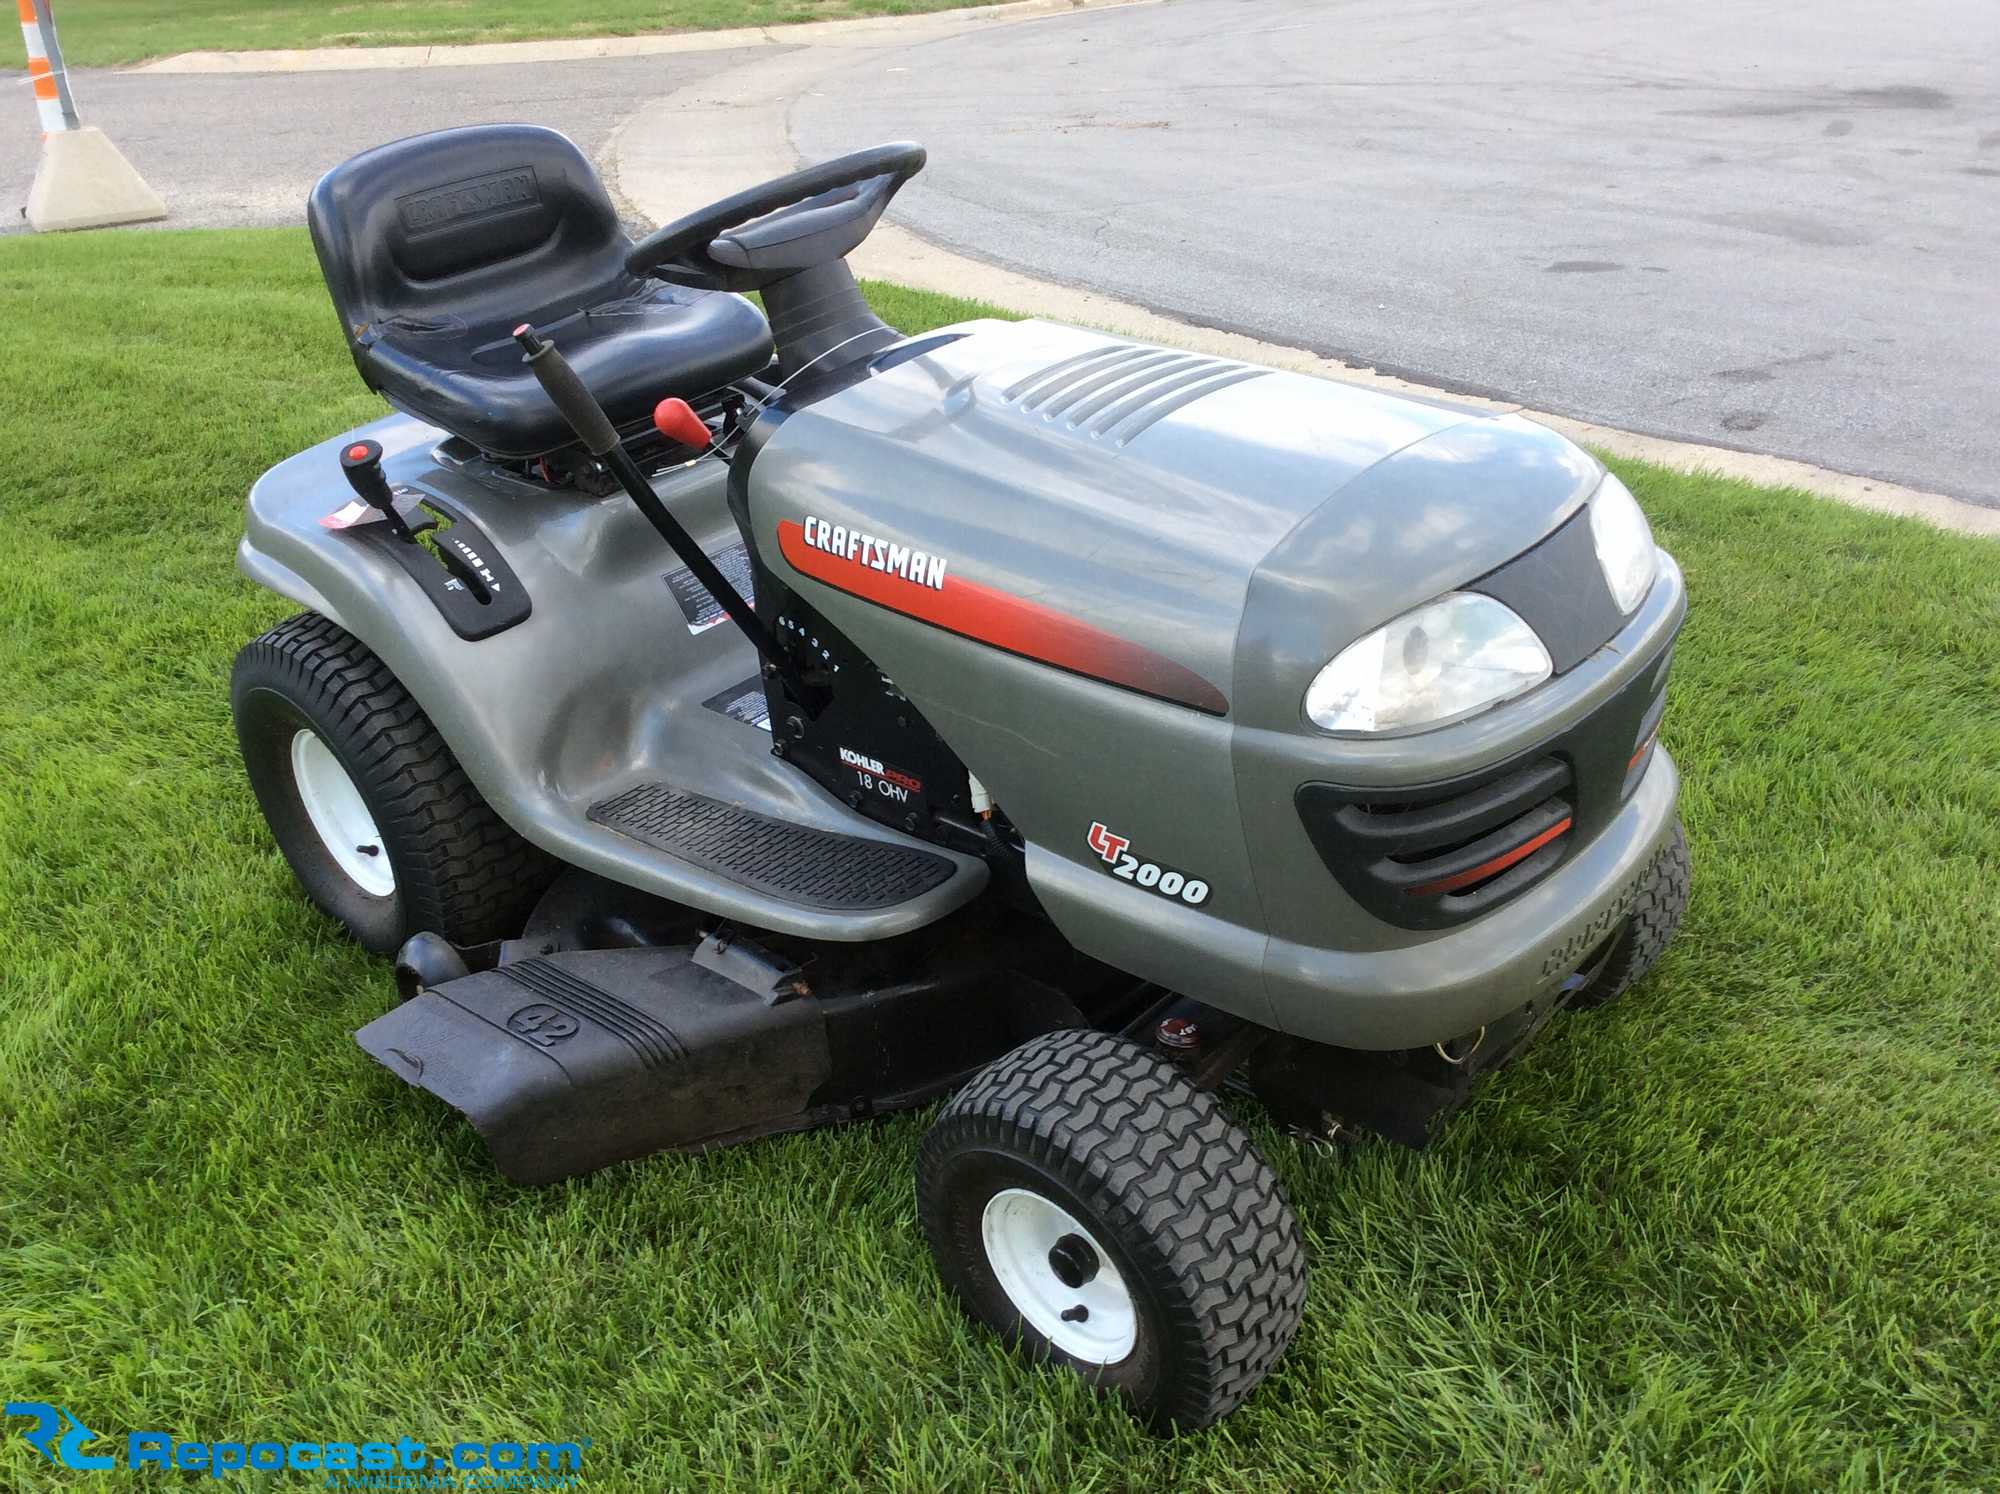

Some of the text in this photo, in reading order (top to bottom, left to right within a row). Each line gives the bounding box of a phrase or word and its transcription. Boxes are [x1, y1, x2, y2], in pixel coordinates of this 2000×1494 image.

[804, 515, 948, 591] CRAFTSMAN
[839, 746, 886, 776] KOHLER
[856, 770, 909, 804] 18 OHV
[509, 1005, 579, 1047] 42
